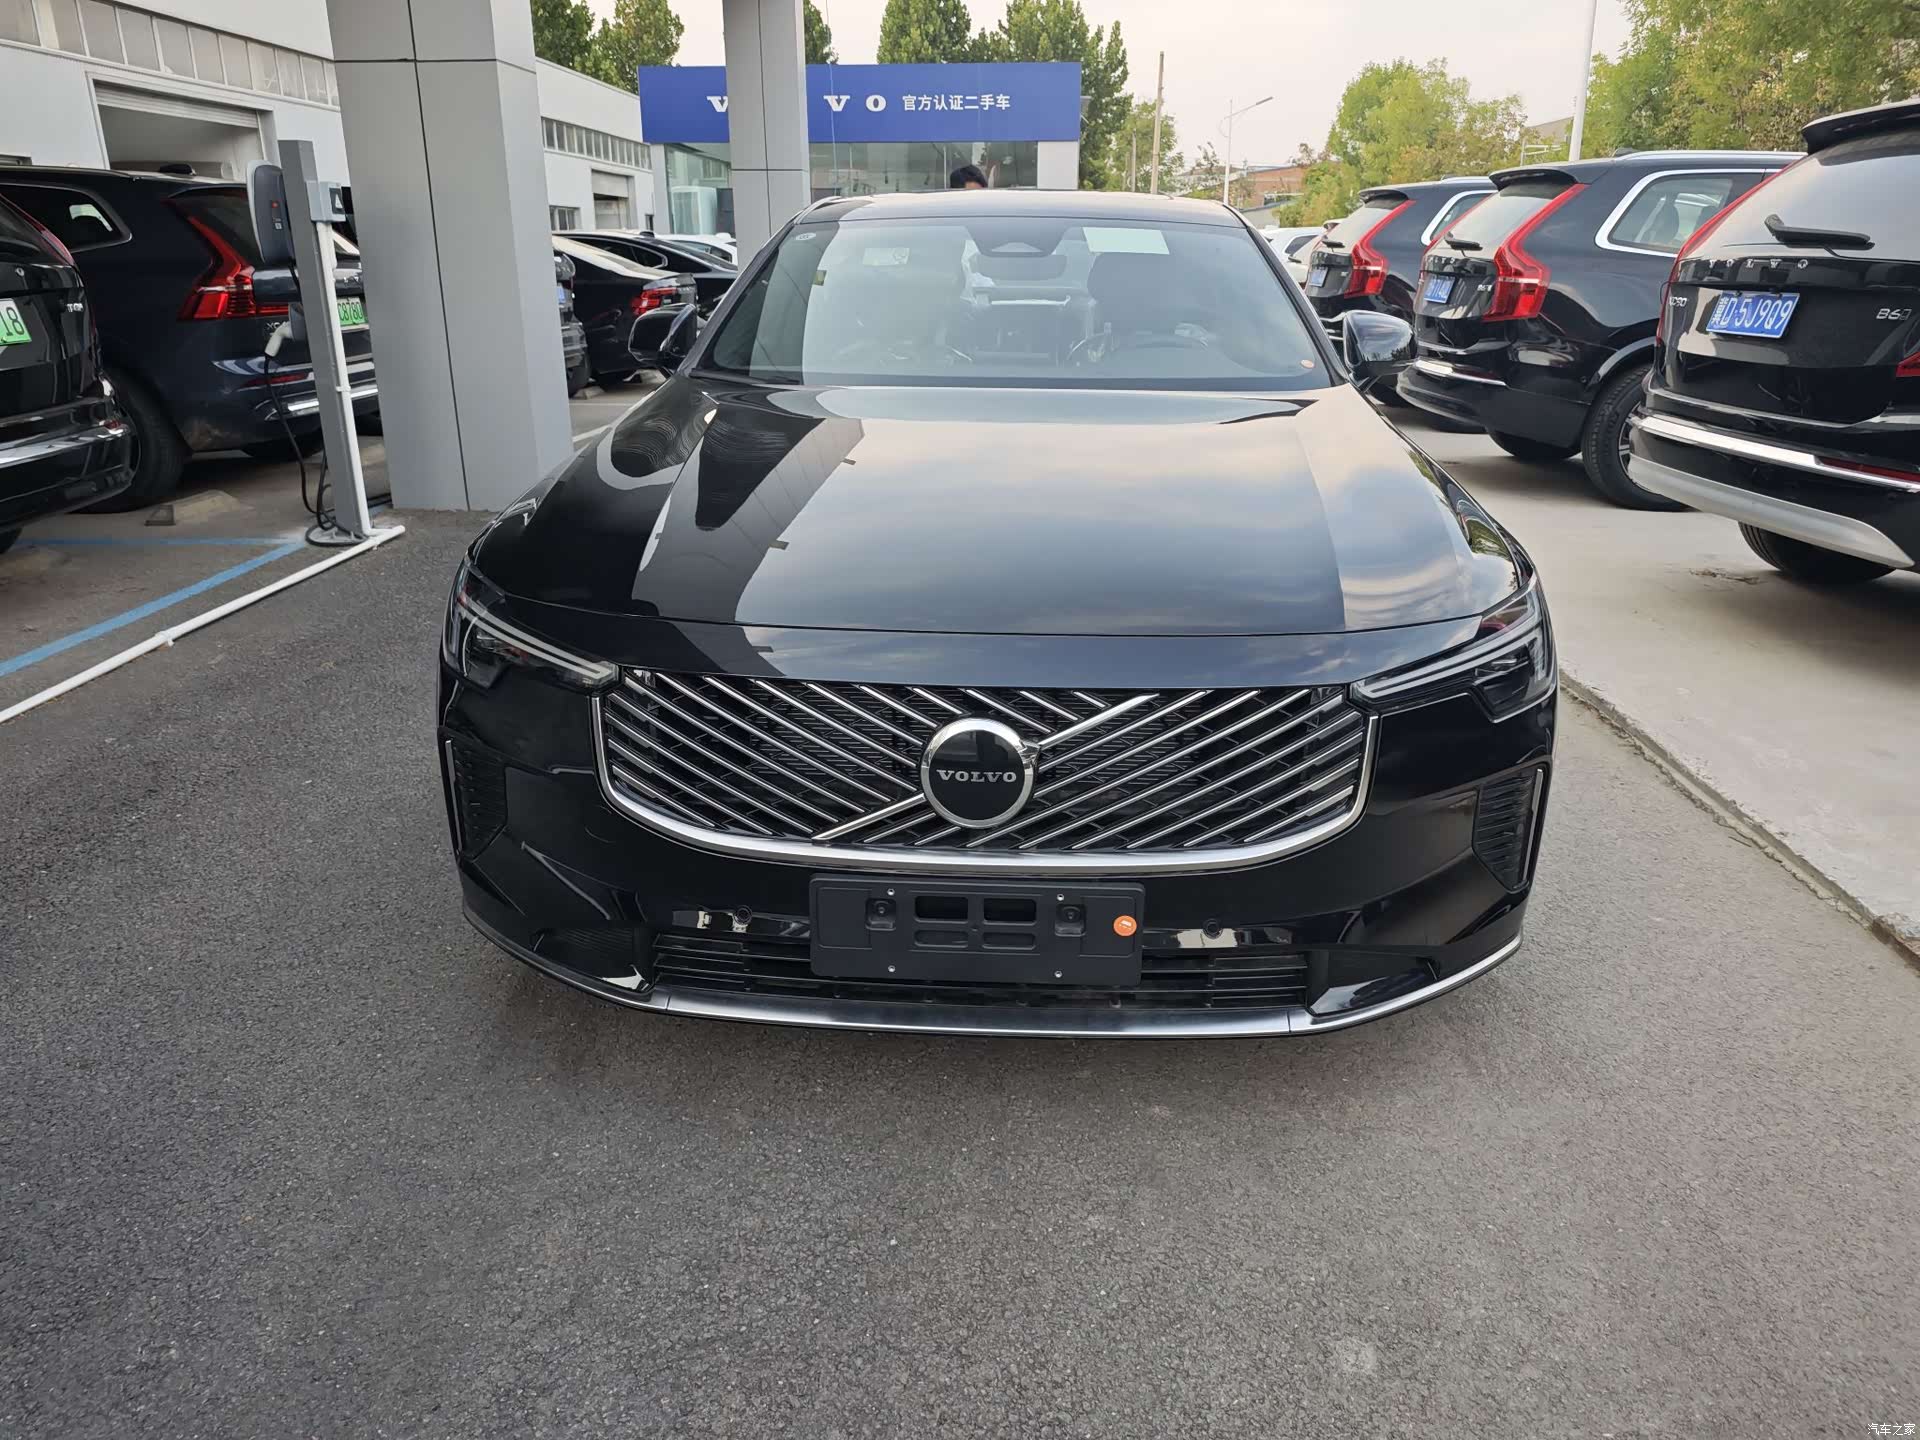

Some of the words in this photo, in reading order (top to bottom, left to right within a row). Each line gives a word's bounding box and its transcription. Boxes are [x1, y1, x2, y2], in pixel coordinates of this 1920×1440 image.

[707, 94, 887, 112] VVO
[902, 94, 1011, 110] 官方认证二手车
[936, 769, 1017, 783] VOLVO
